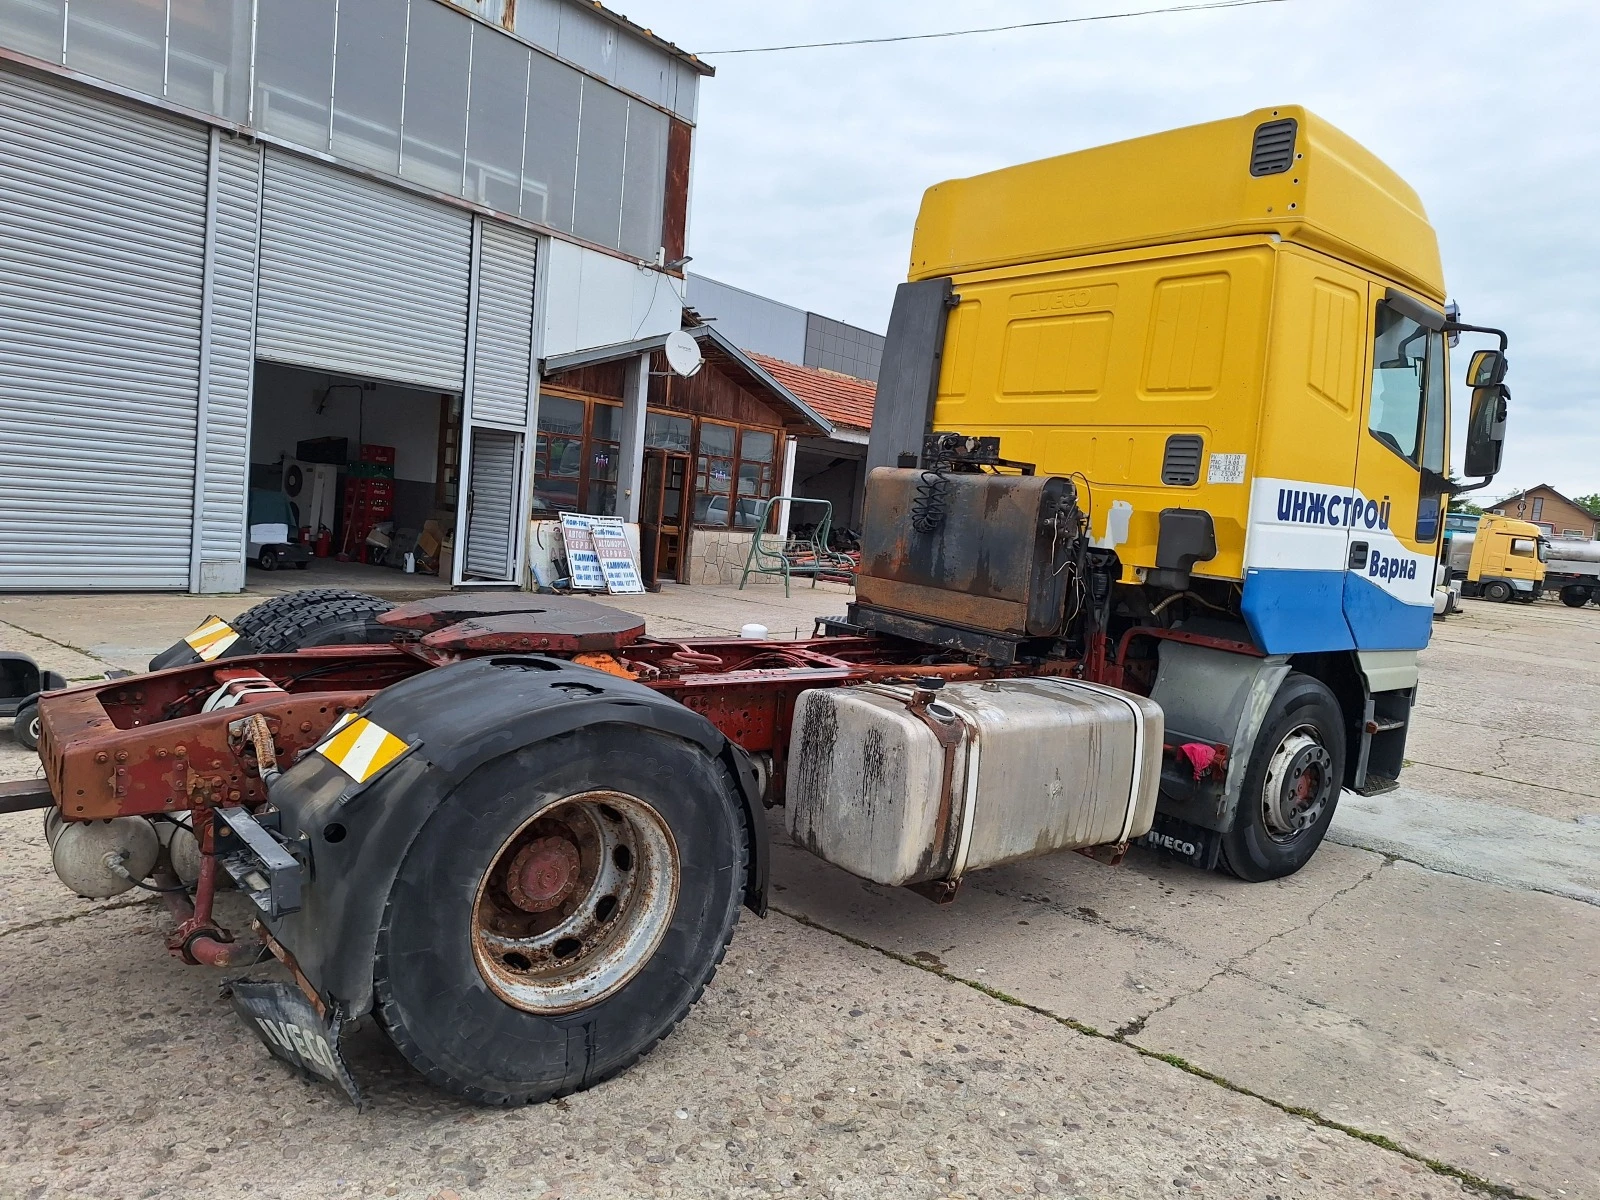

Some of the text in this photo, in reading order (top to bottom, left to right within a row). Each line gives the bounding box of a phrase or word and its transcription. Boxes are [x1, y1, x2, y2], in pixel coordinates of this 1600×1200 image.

[1030, 288, 1092, 312] IVECO
[1277, 488, 1391, 531] ИНЖСТРОЙ
[574, 553, 599, 563] КАМИОН
[602, 549, 627, 558] СЕРВИЗ
[1369, 550, 1417, 583] Варна
[1148, 830, 1196, 856] IVECO
